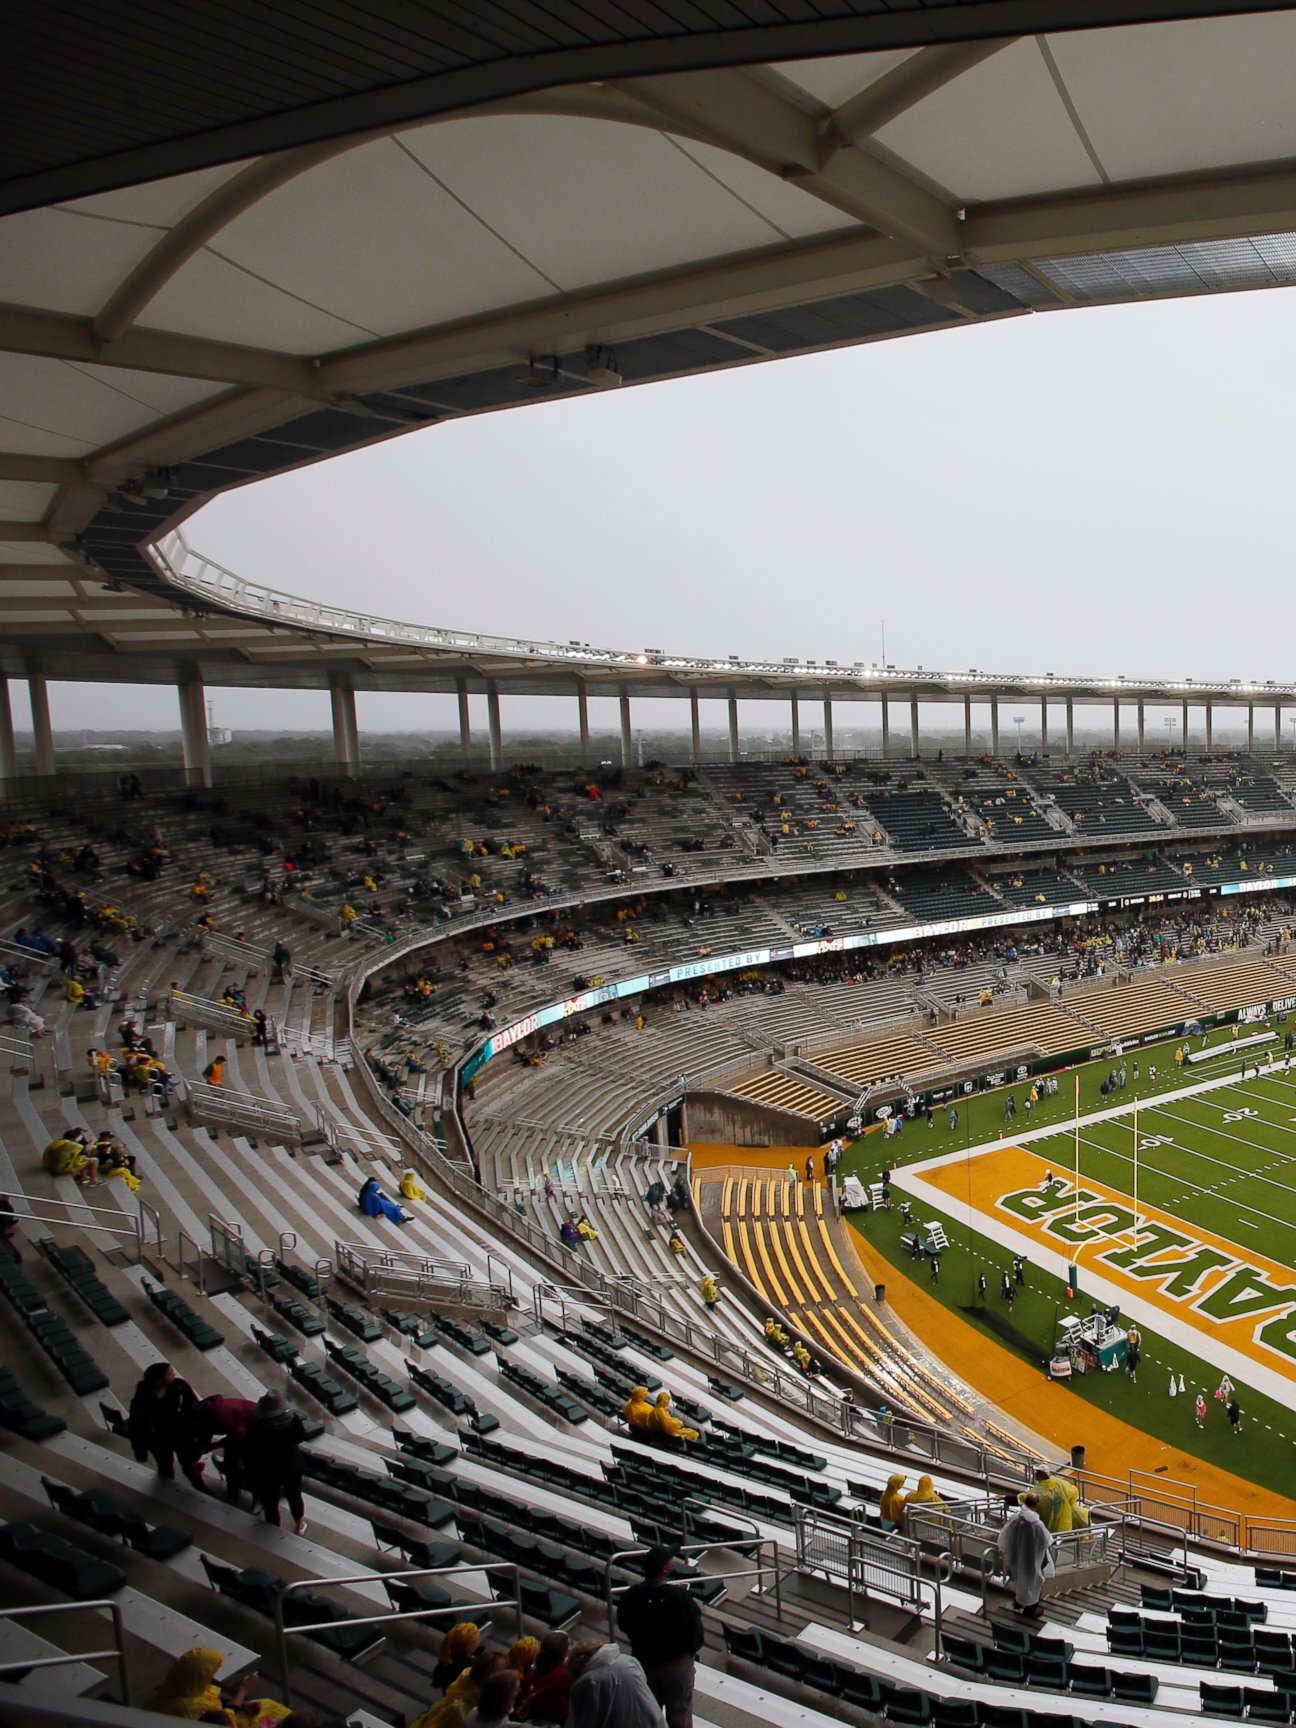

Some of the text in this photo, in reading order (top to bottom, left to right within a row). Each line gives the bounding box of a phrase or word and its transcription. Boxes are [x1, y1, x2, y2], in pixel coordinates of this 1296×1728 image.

[1240, 879, 1277, 892] BAYLOR
[912, 920, 968, 938] BAYLOR
[982, 912, 1031, 928] PRESENTED
[677, 953, 761, 978] PRESENTED BY
[1238, 1004, 1267, 1020] ALWAYS
[492, 1013, 539, 1052] BAYLOR
